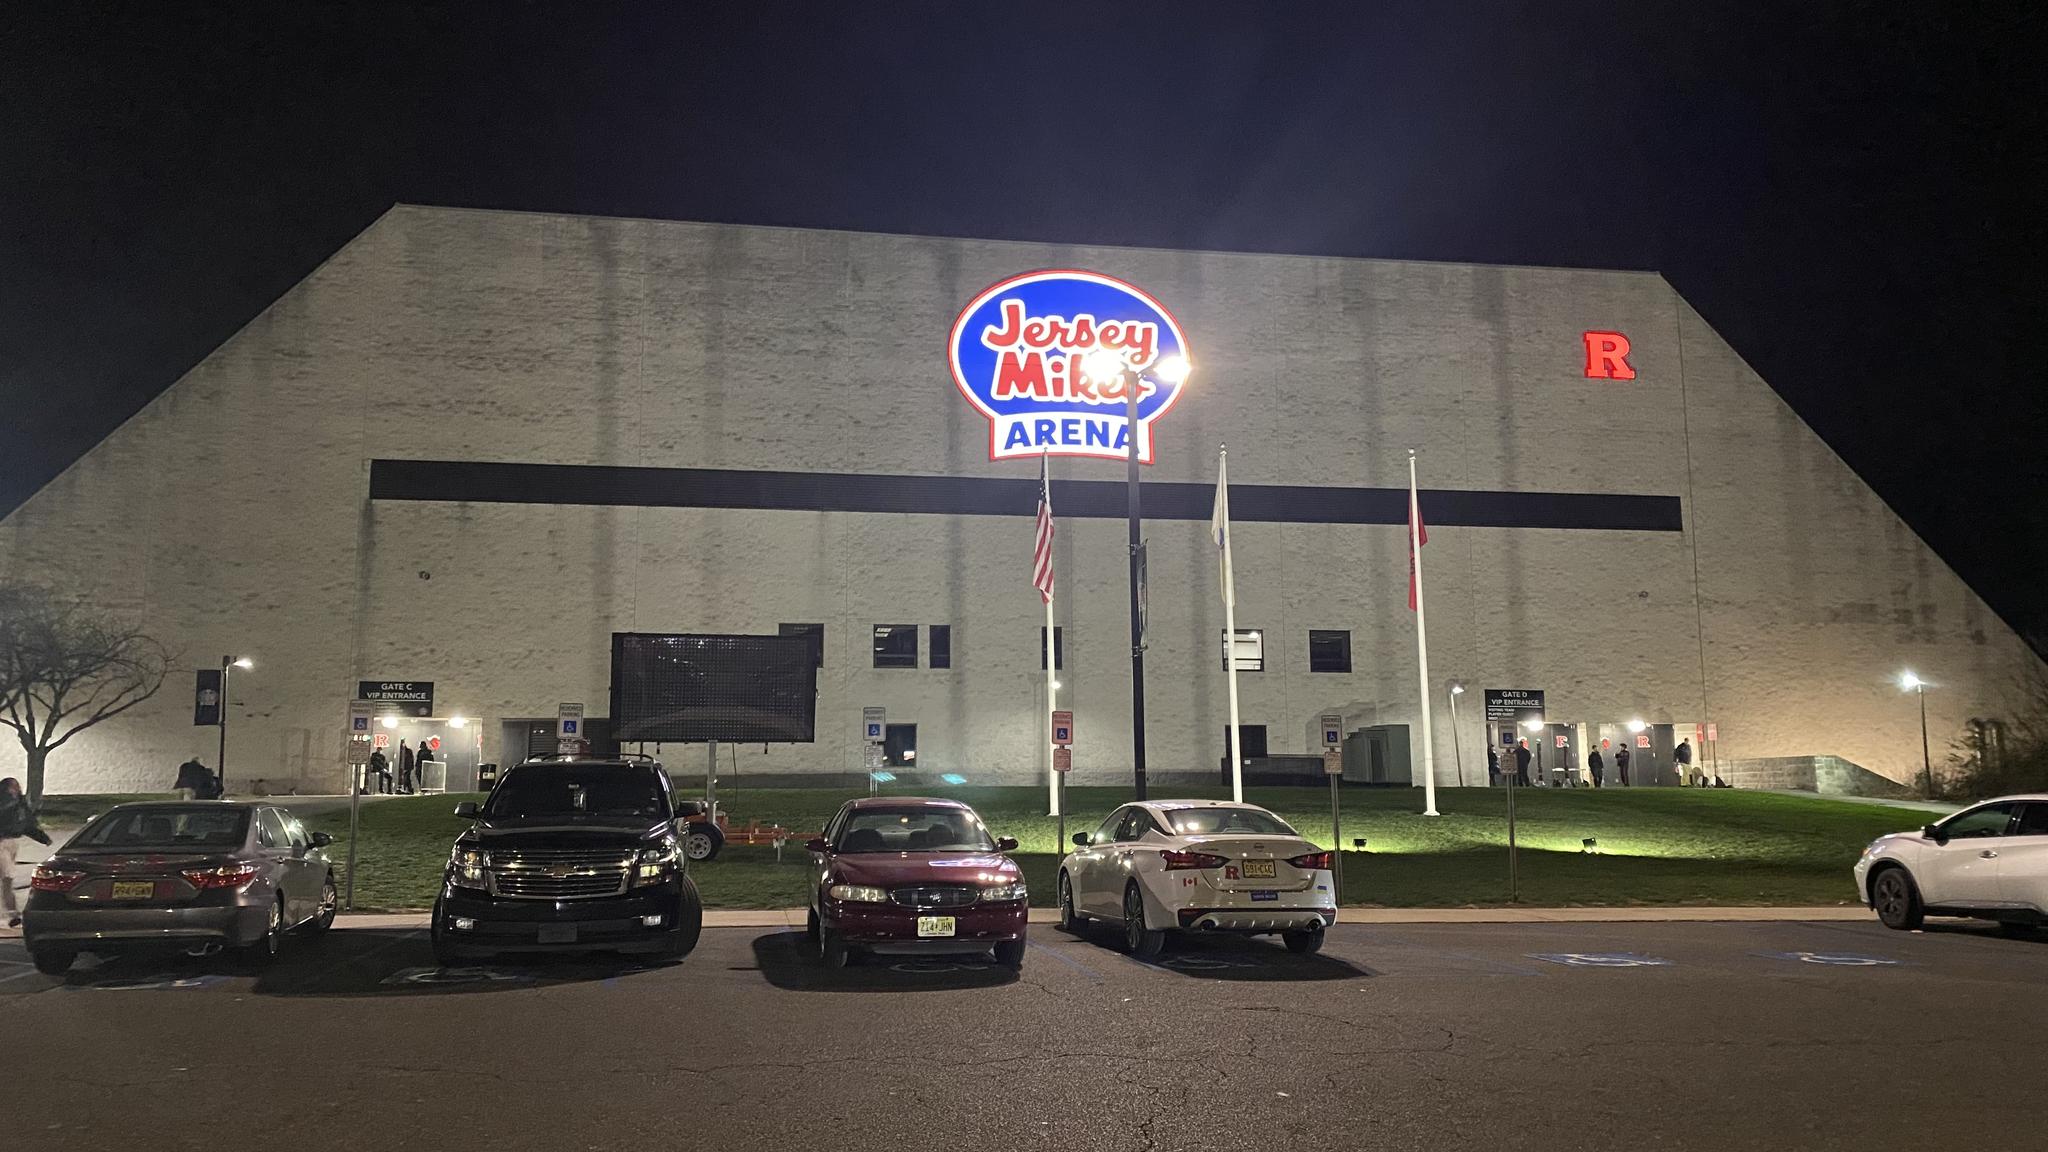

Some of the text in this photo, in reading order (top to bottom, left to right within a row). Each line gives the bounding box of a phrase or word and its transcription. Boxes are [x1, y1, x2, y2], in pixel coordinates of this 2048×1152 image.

[986, 303, 1153, 365] Jersey
[1583, 331, 1636, 379] R
[1004, 418, 1140, 451] ARENA
[381, 683, 413, 691] GATE C
[1225, 865, 1240, 881] R
